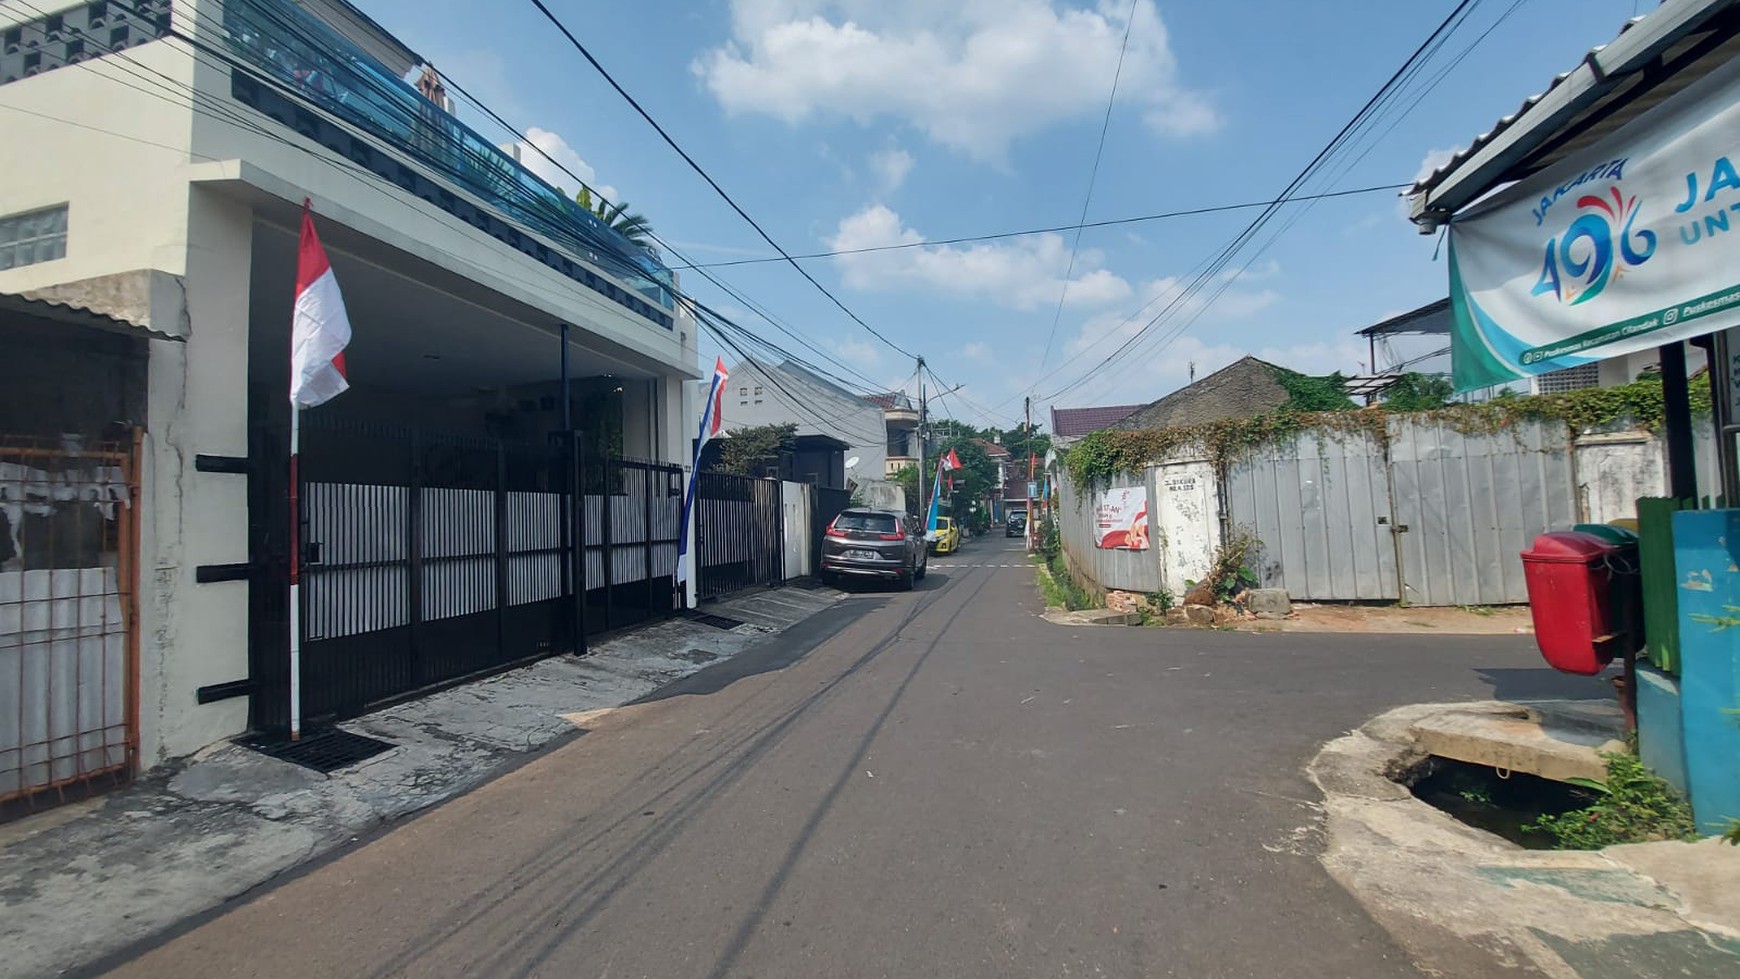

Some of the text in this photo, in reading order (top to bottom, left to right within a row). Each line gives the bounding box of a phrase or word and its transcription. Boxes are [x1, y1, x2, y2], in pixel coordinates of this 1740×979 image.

[1532, 157, 1630, 227] JAKARTA
[1530, 199, 1657, 307] 496
[1621, 317, 1660, 337] Cilandak
